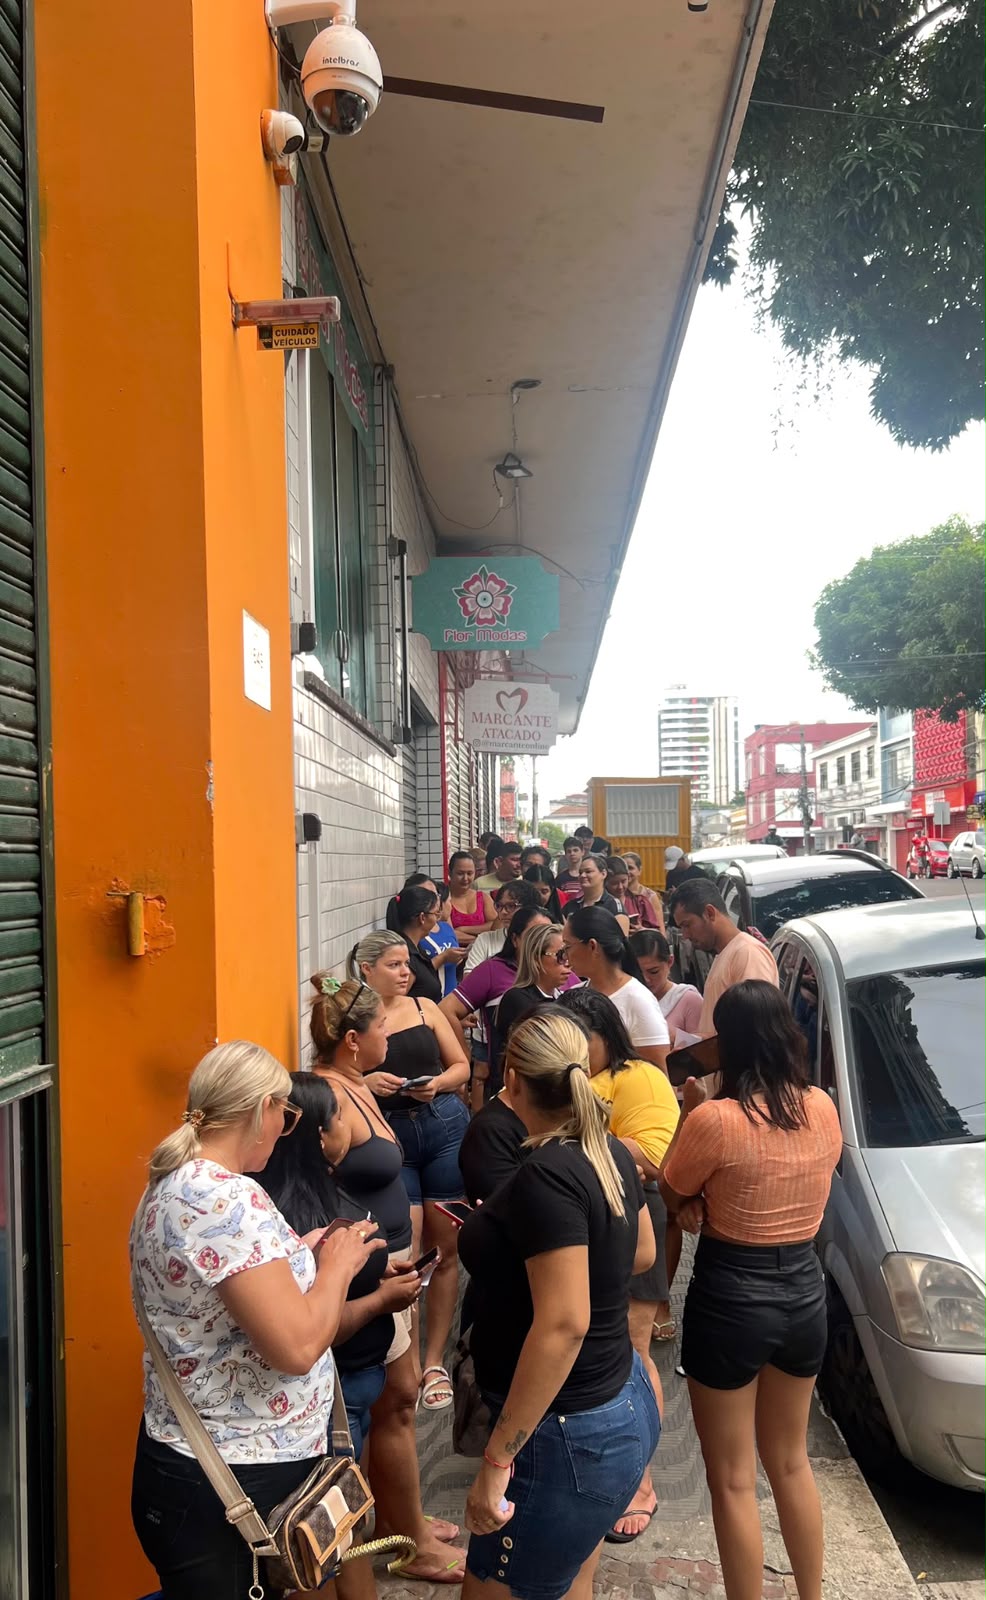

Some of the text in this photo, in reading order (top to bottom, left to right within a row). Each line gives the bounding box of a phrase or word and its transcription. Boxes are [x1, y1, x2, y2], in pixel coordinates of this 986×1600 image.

[322, 56, 359, 66] intelbras
[274, 327, 316, 337] CUIDADO
[273, 337, 317, 346] VEÍCULOS
[444, 628, 527, 642] Flor Modas
[471, 711, 552, 728] MARCANTE
[481, 728, 542, 742] ATACADO
